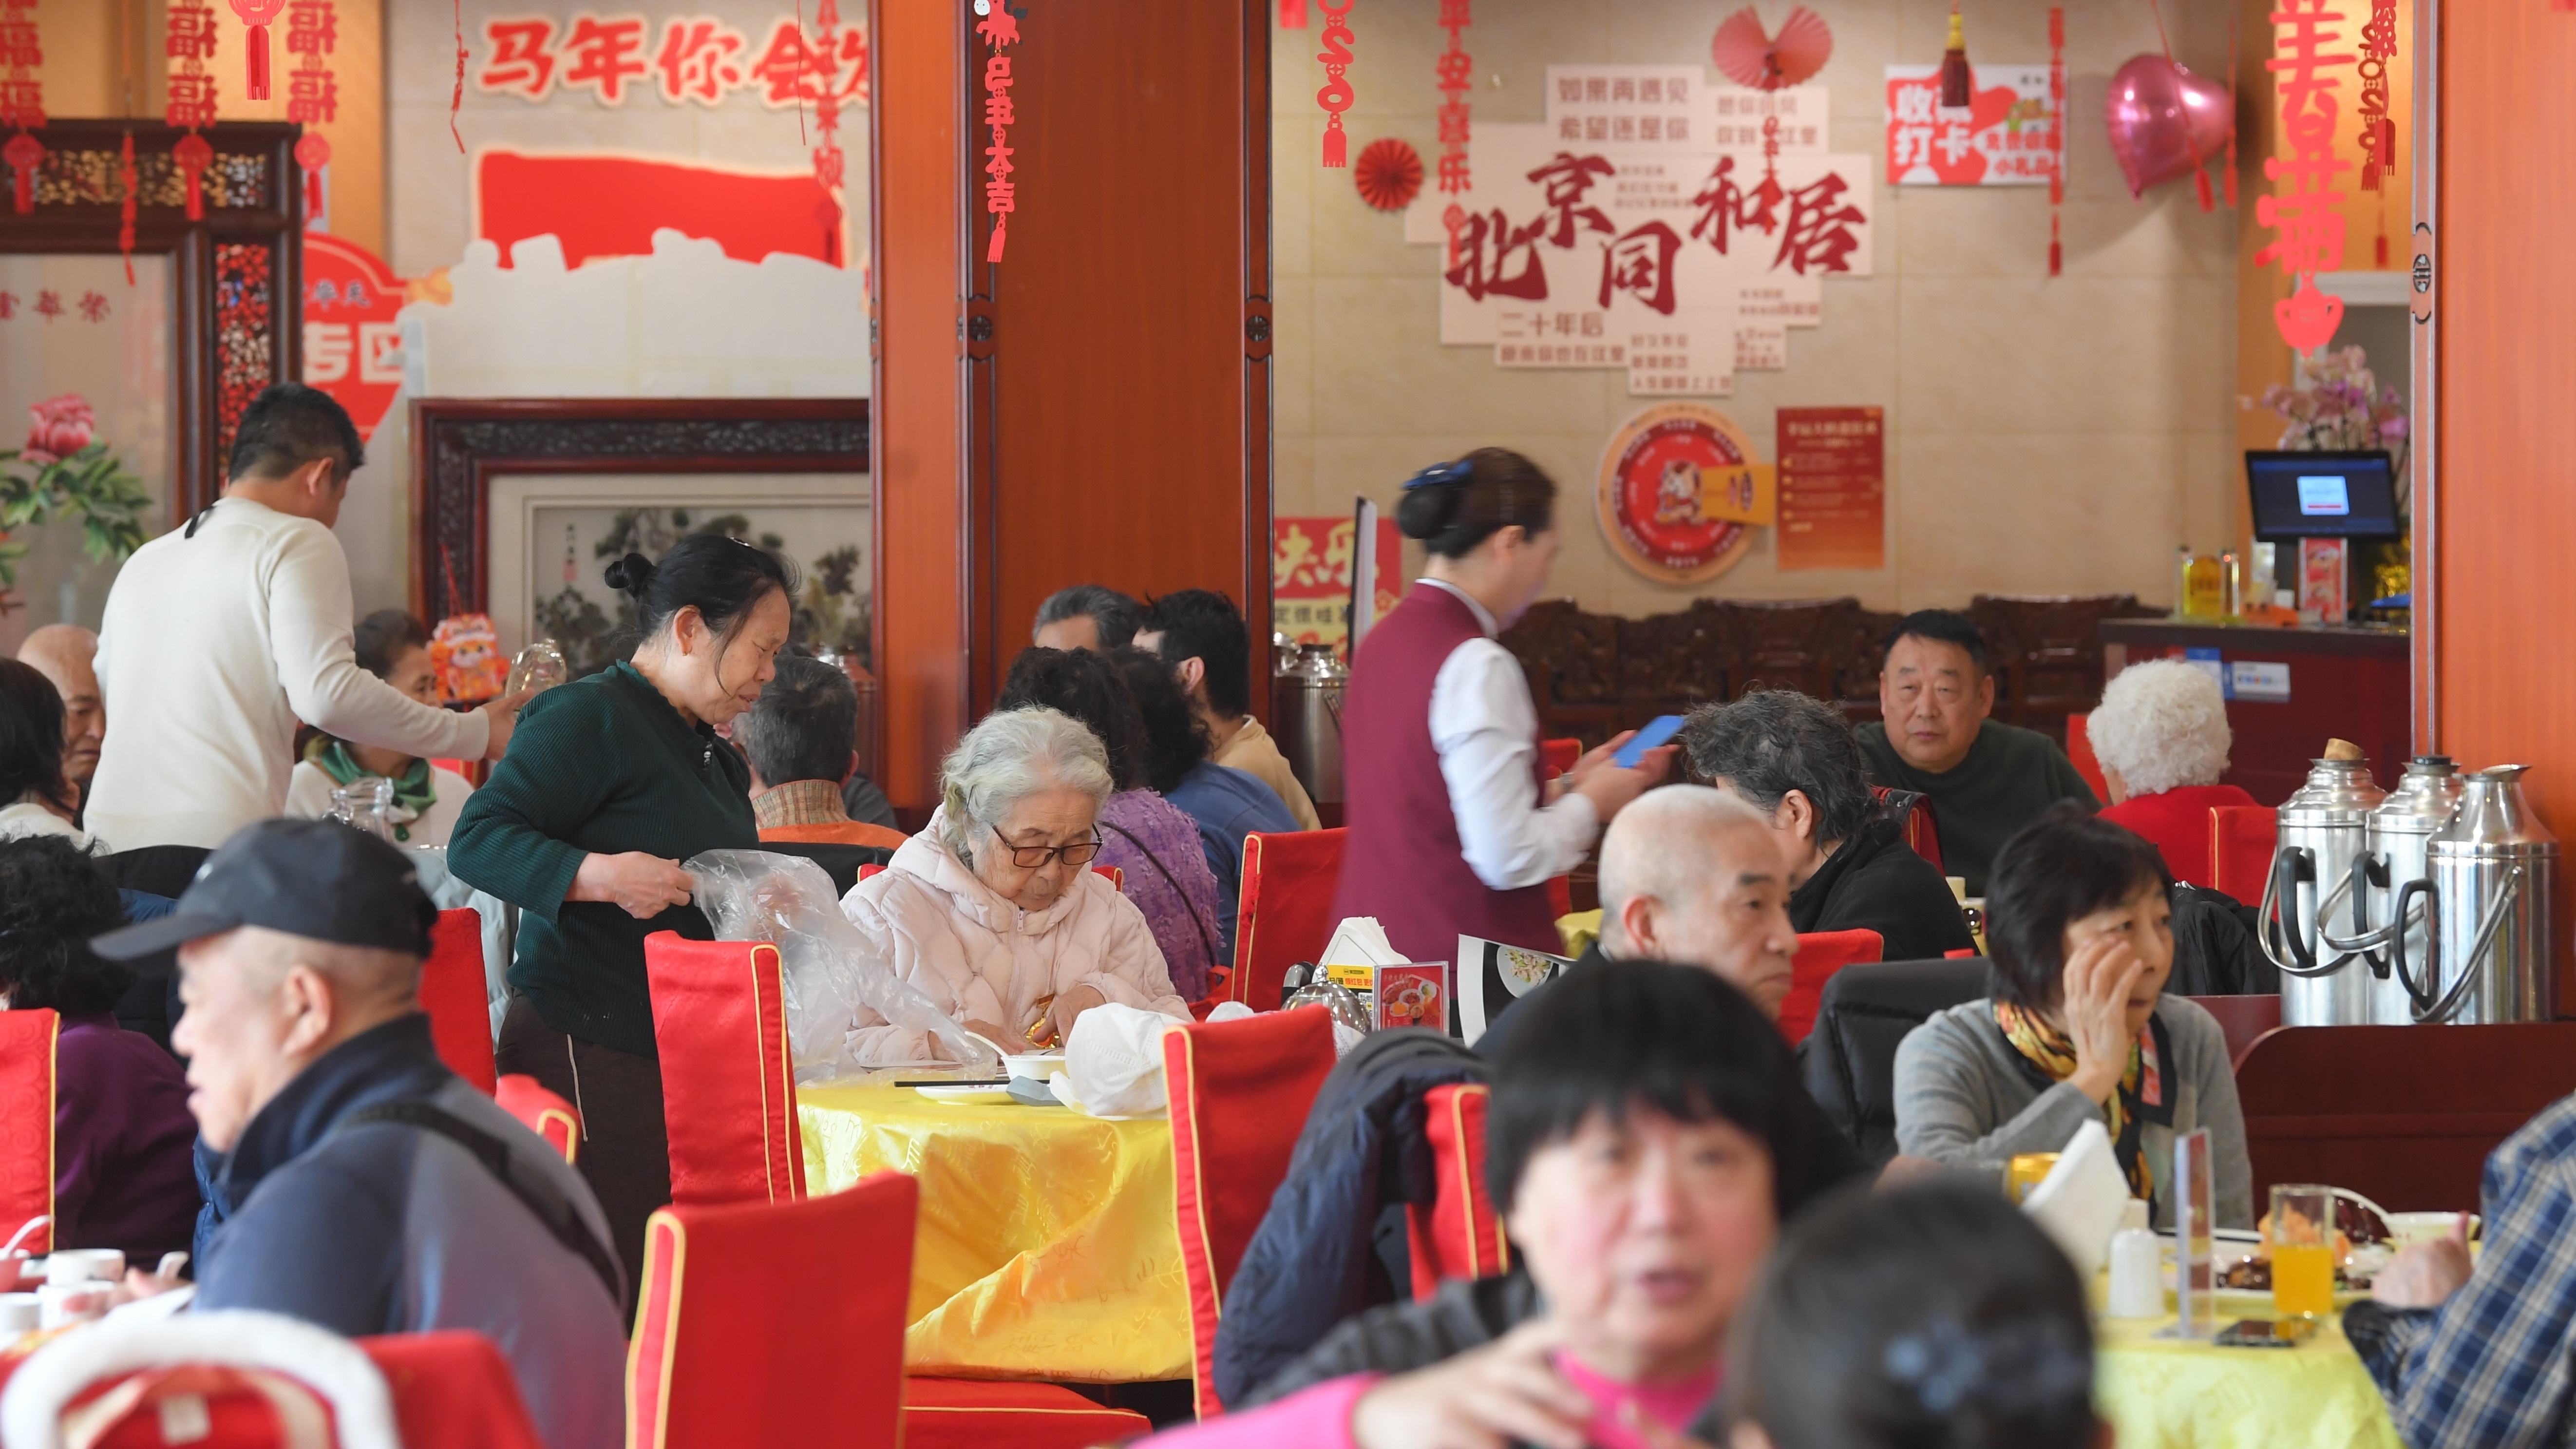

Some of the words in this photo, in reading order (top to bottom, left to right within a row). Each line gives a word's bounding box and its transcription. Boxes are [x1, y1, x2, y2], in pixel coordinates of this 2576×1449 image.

[1894, 126, 1974, 166] 打卡
[1500, 312, 1604, 337] 二十年后
